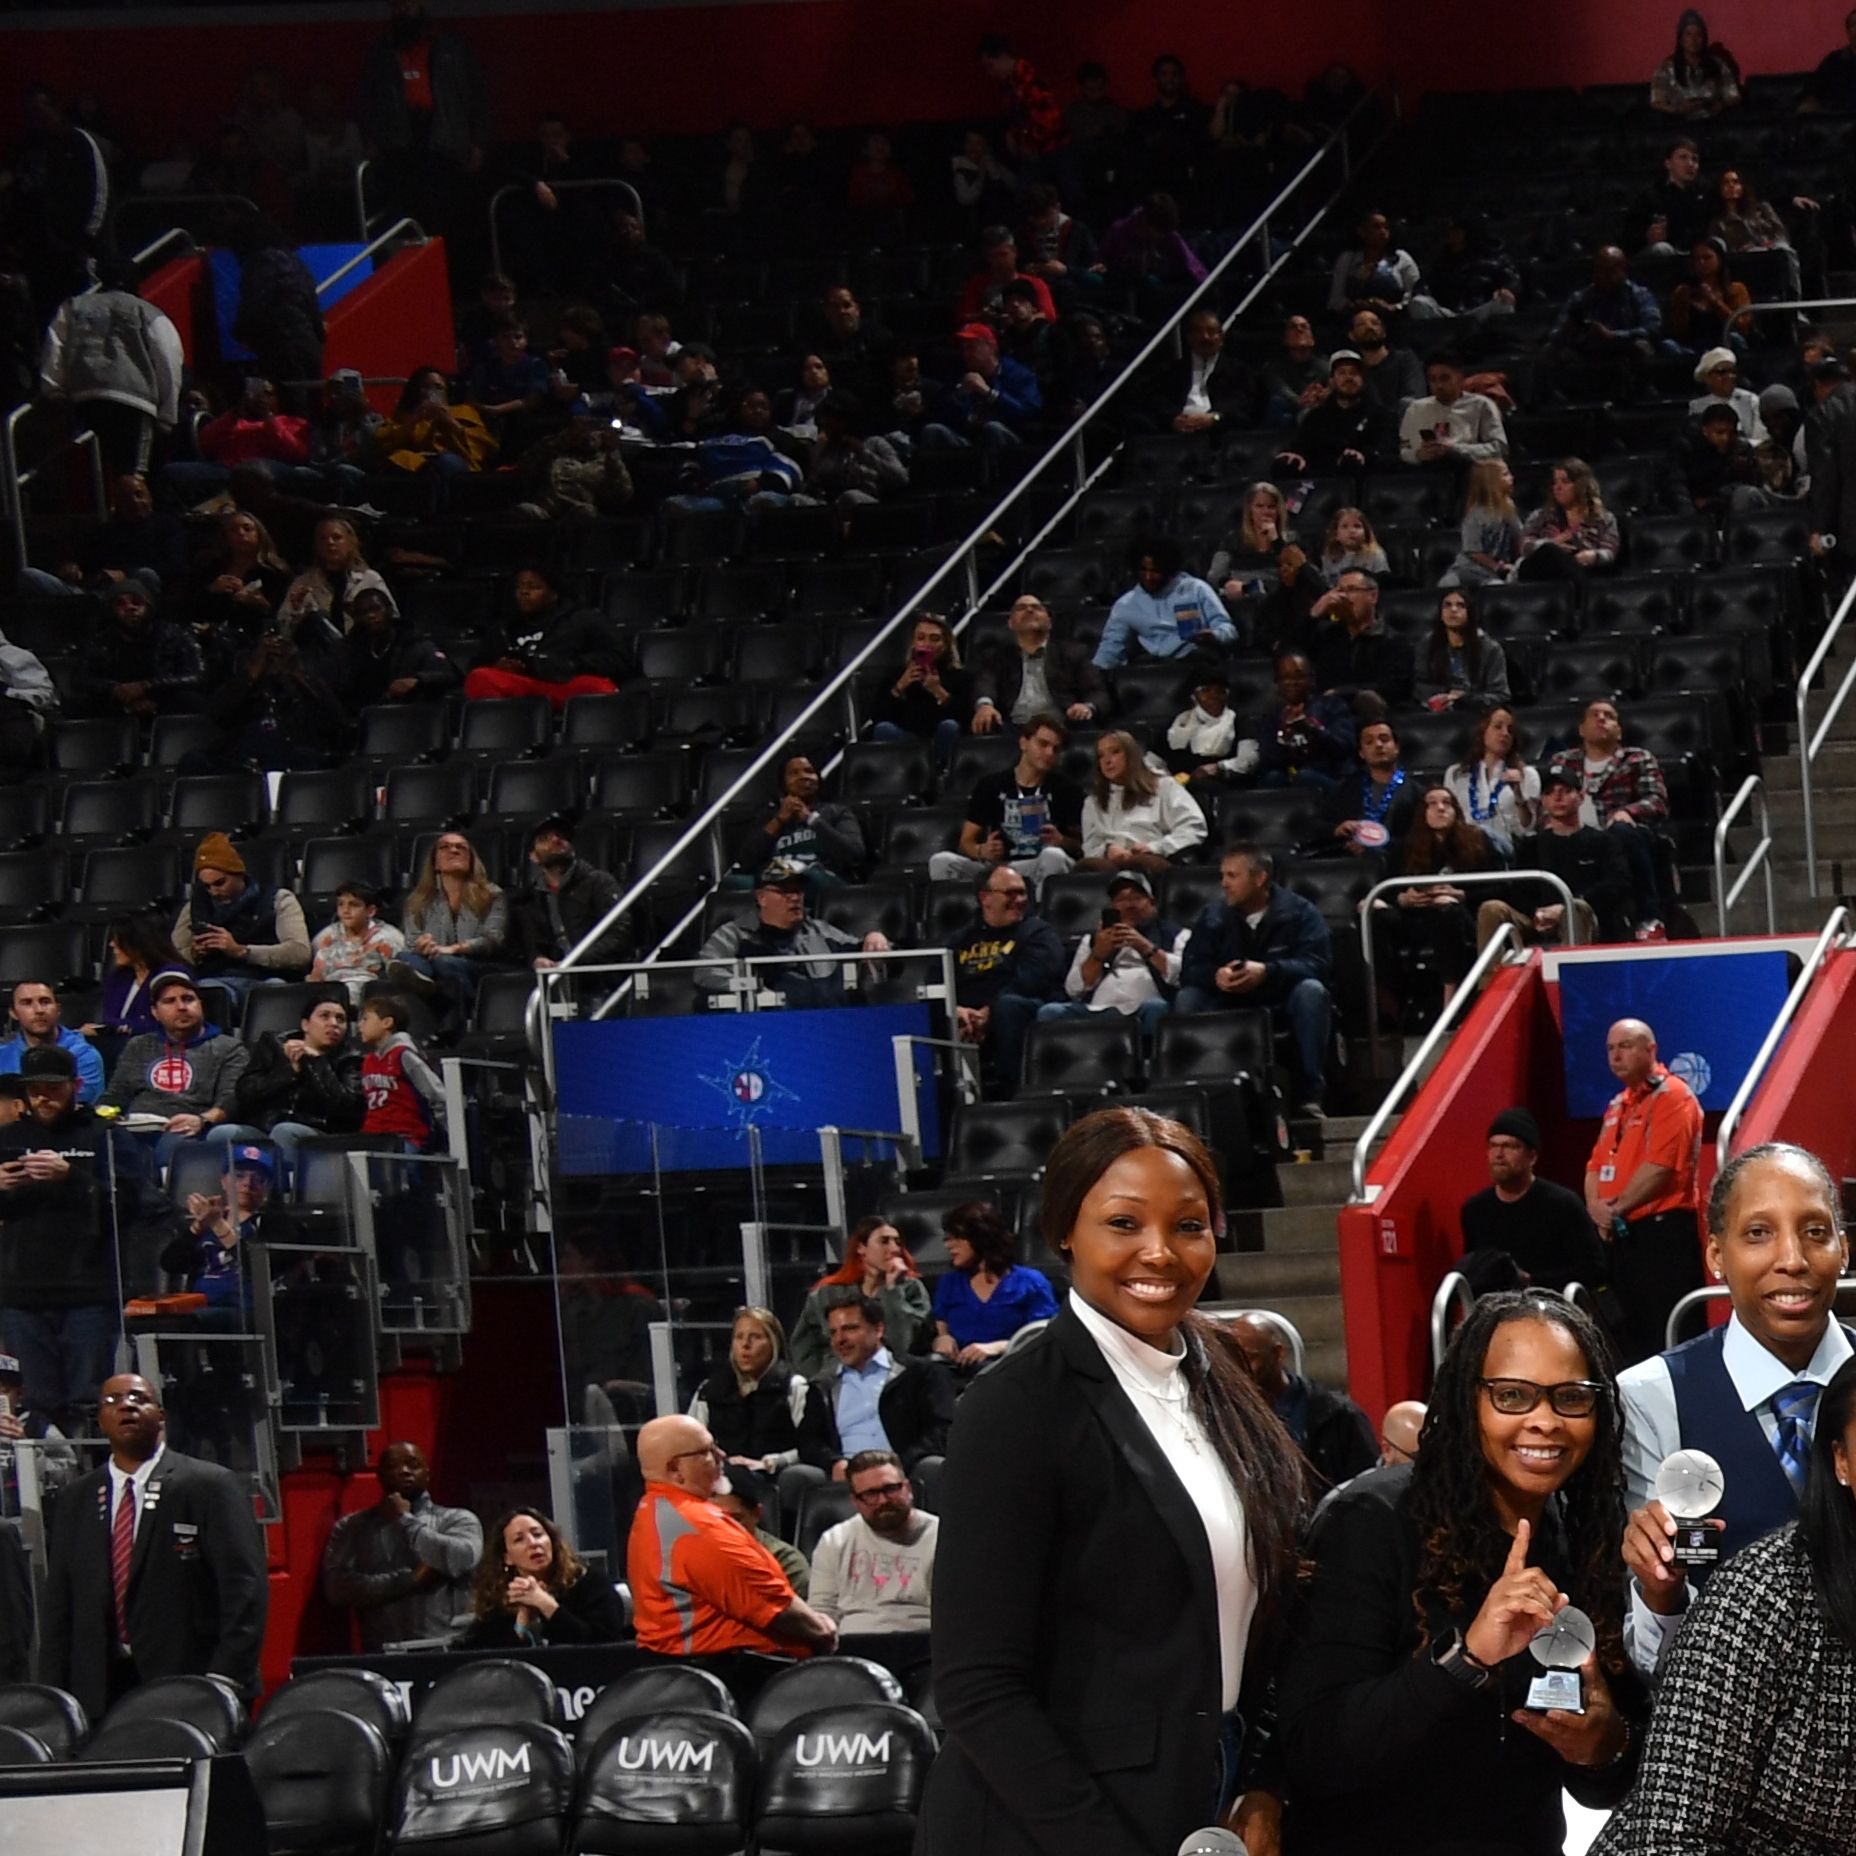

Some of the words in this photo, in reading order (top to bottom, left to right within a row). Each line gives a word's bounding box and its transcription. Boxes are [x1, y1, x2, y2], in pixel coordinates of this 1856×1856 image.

[432, 1743, 531, 1788] UWM
[618, 1737, 718, 1772] UWM
[796, 1730, 892, 1767] UWM
